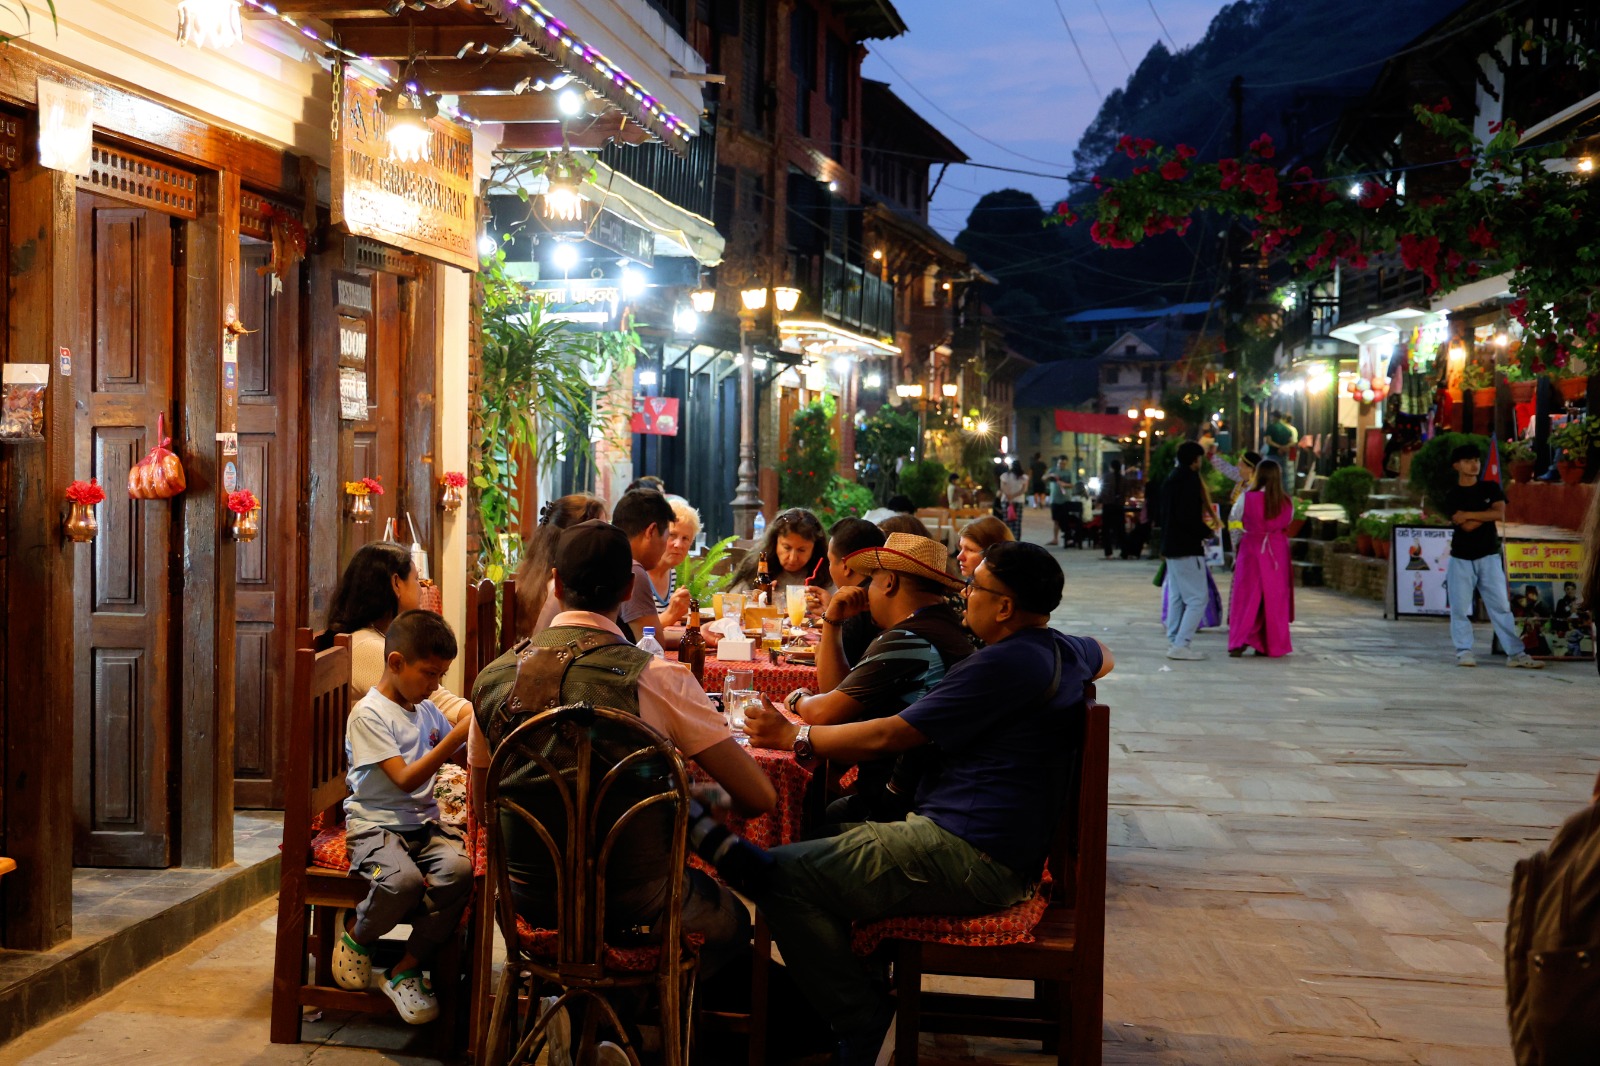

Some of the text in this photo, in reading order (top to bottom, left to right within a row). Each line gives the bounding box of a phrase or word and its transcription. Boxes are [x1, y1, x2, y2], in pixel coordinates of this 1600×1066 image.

[350, 149, 375, 181] WITH
[417, 176, 467, 220] RESTAURANT
[340, 328, 367, 360] ROOM
